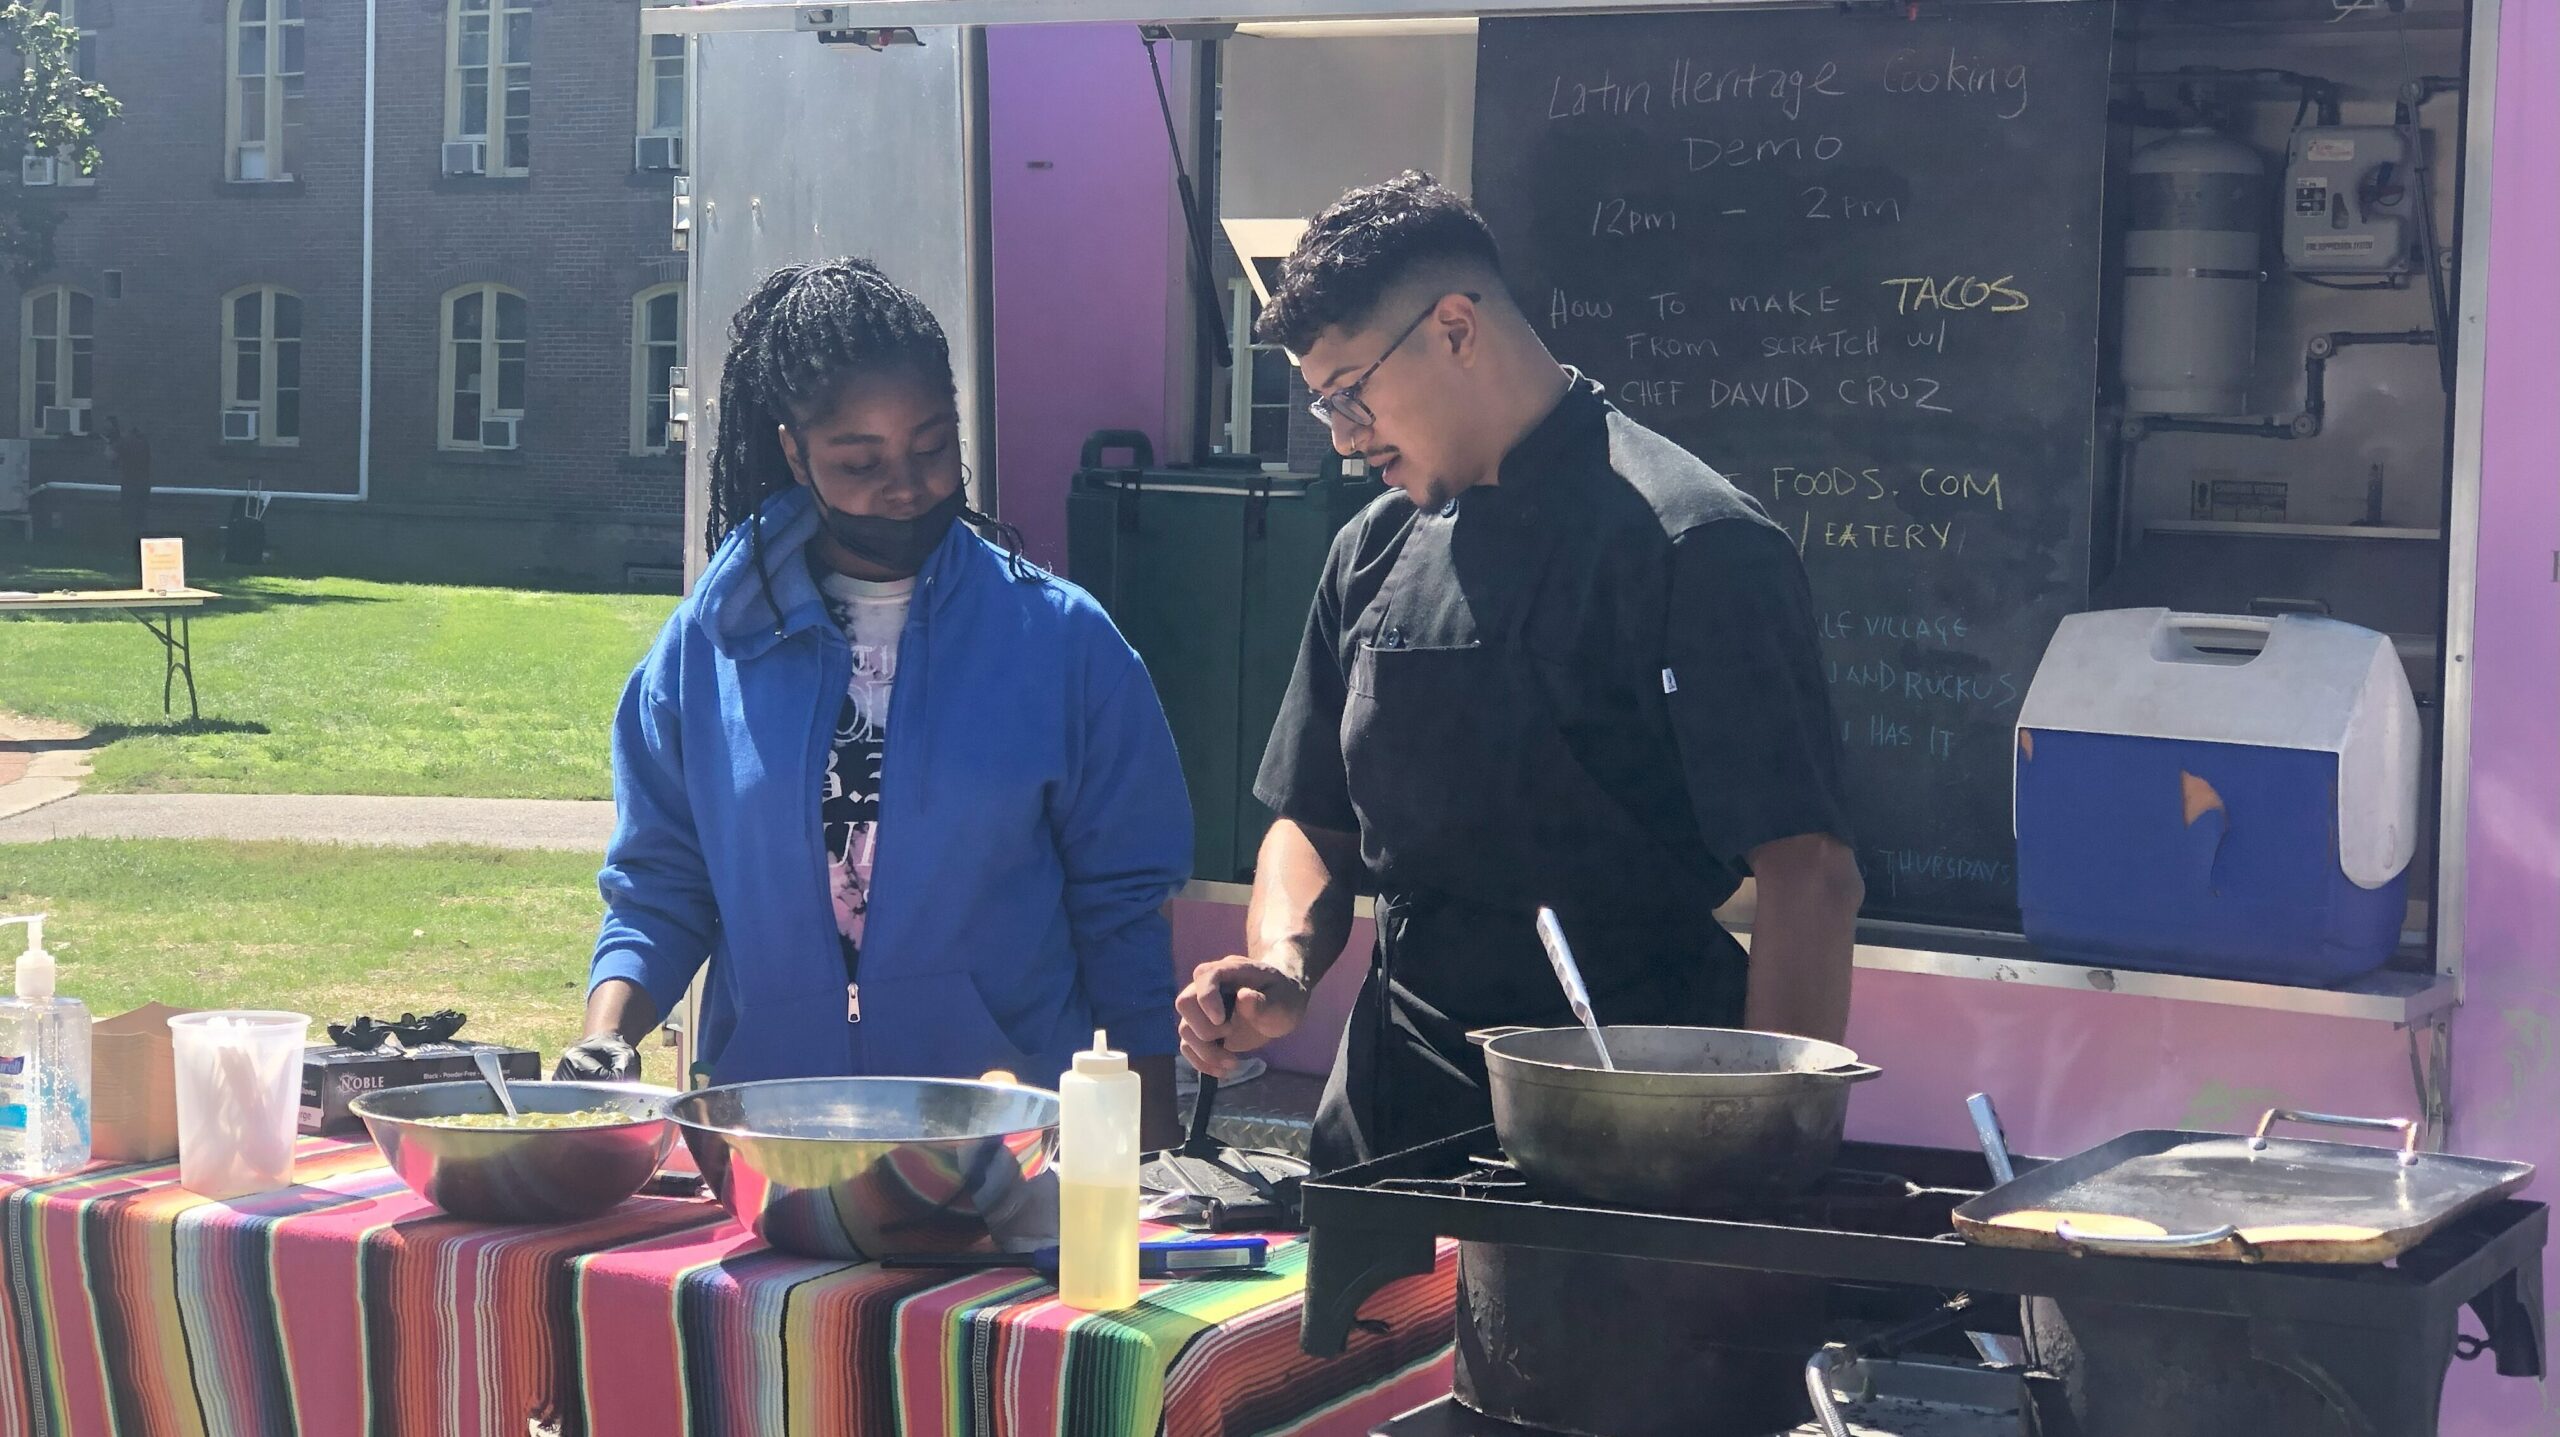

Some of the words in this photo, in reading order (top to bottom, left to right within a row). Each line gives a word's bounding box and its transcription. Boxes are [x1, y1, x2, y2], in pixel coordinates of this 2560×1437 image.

[1548, 68, 1651, 119] Latin
[1671, 57, 1846, 121] Heritage
[1883, 47, 2028, 119] Cooking
[1880, 275, 2030, 316] TACOS
[1760, 326, 1880, 358] SCRATCH
[1620, 380, 1685, 407] CHEF
[1710, 376, 1810, 410] DAVID
[1838, 375, 1953, 413] CRUZ
[1863, 614, 1969, 646] VILLAGE
[1904, 671, 2017, 710] RUCKUS
[1870, 713, 1912, 747] HAS
[340, 1075, 385, 1092] NOBLE
